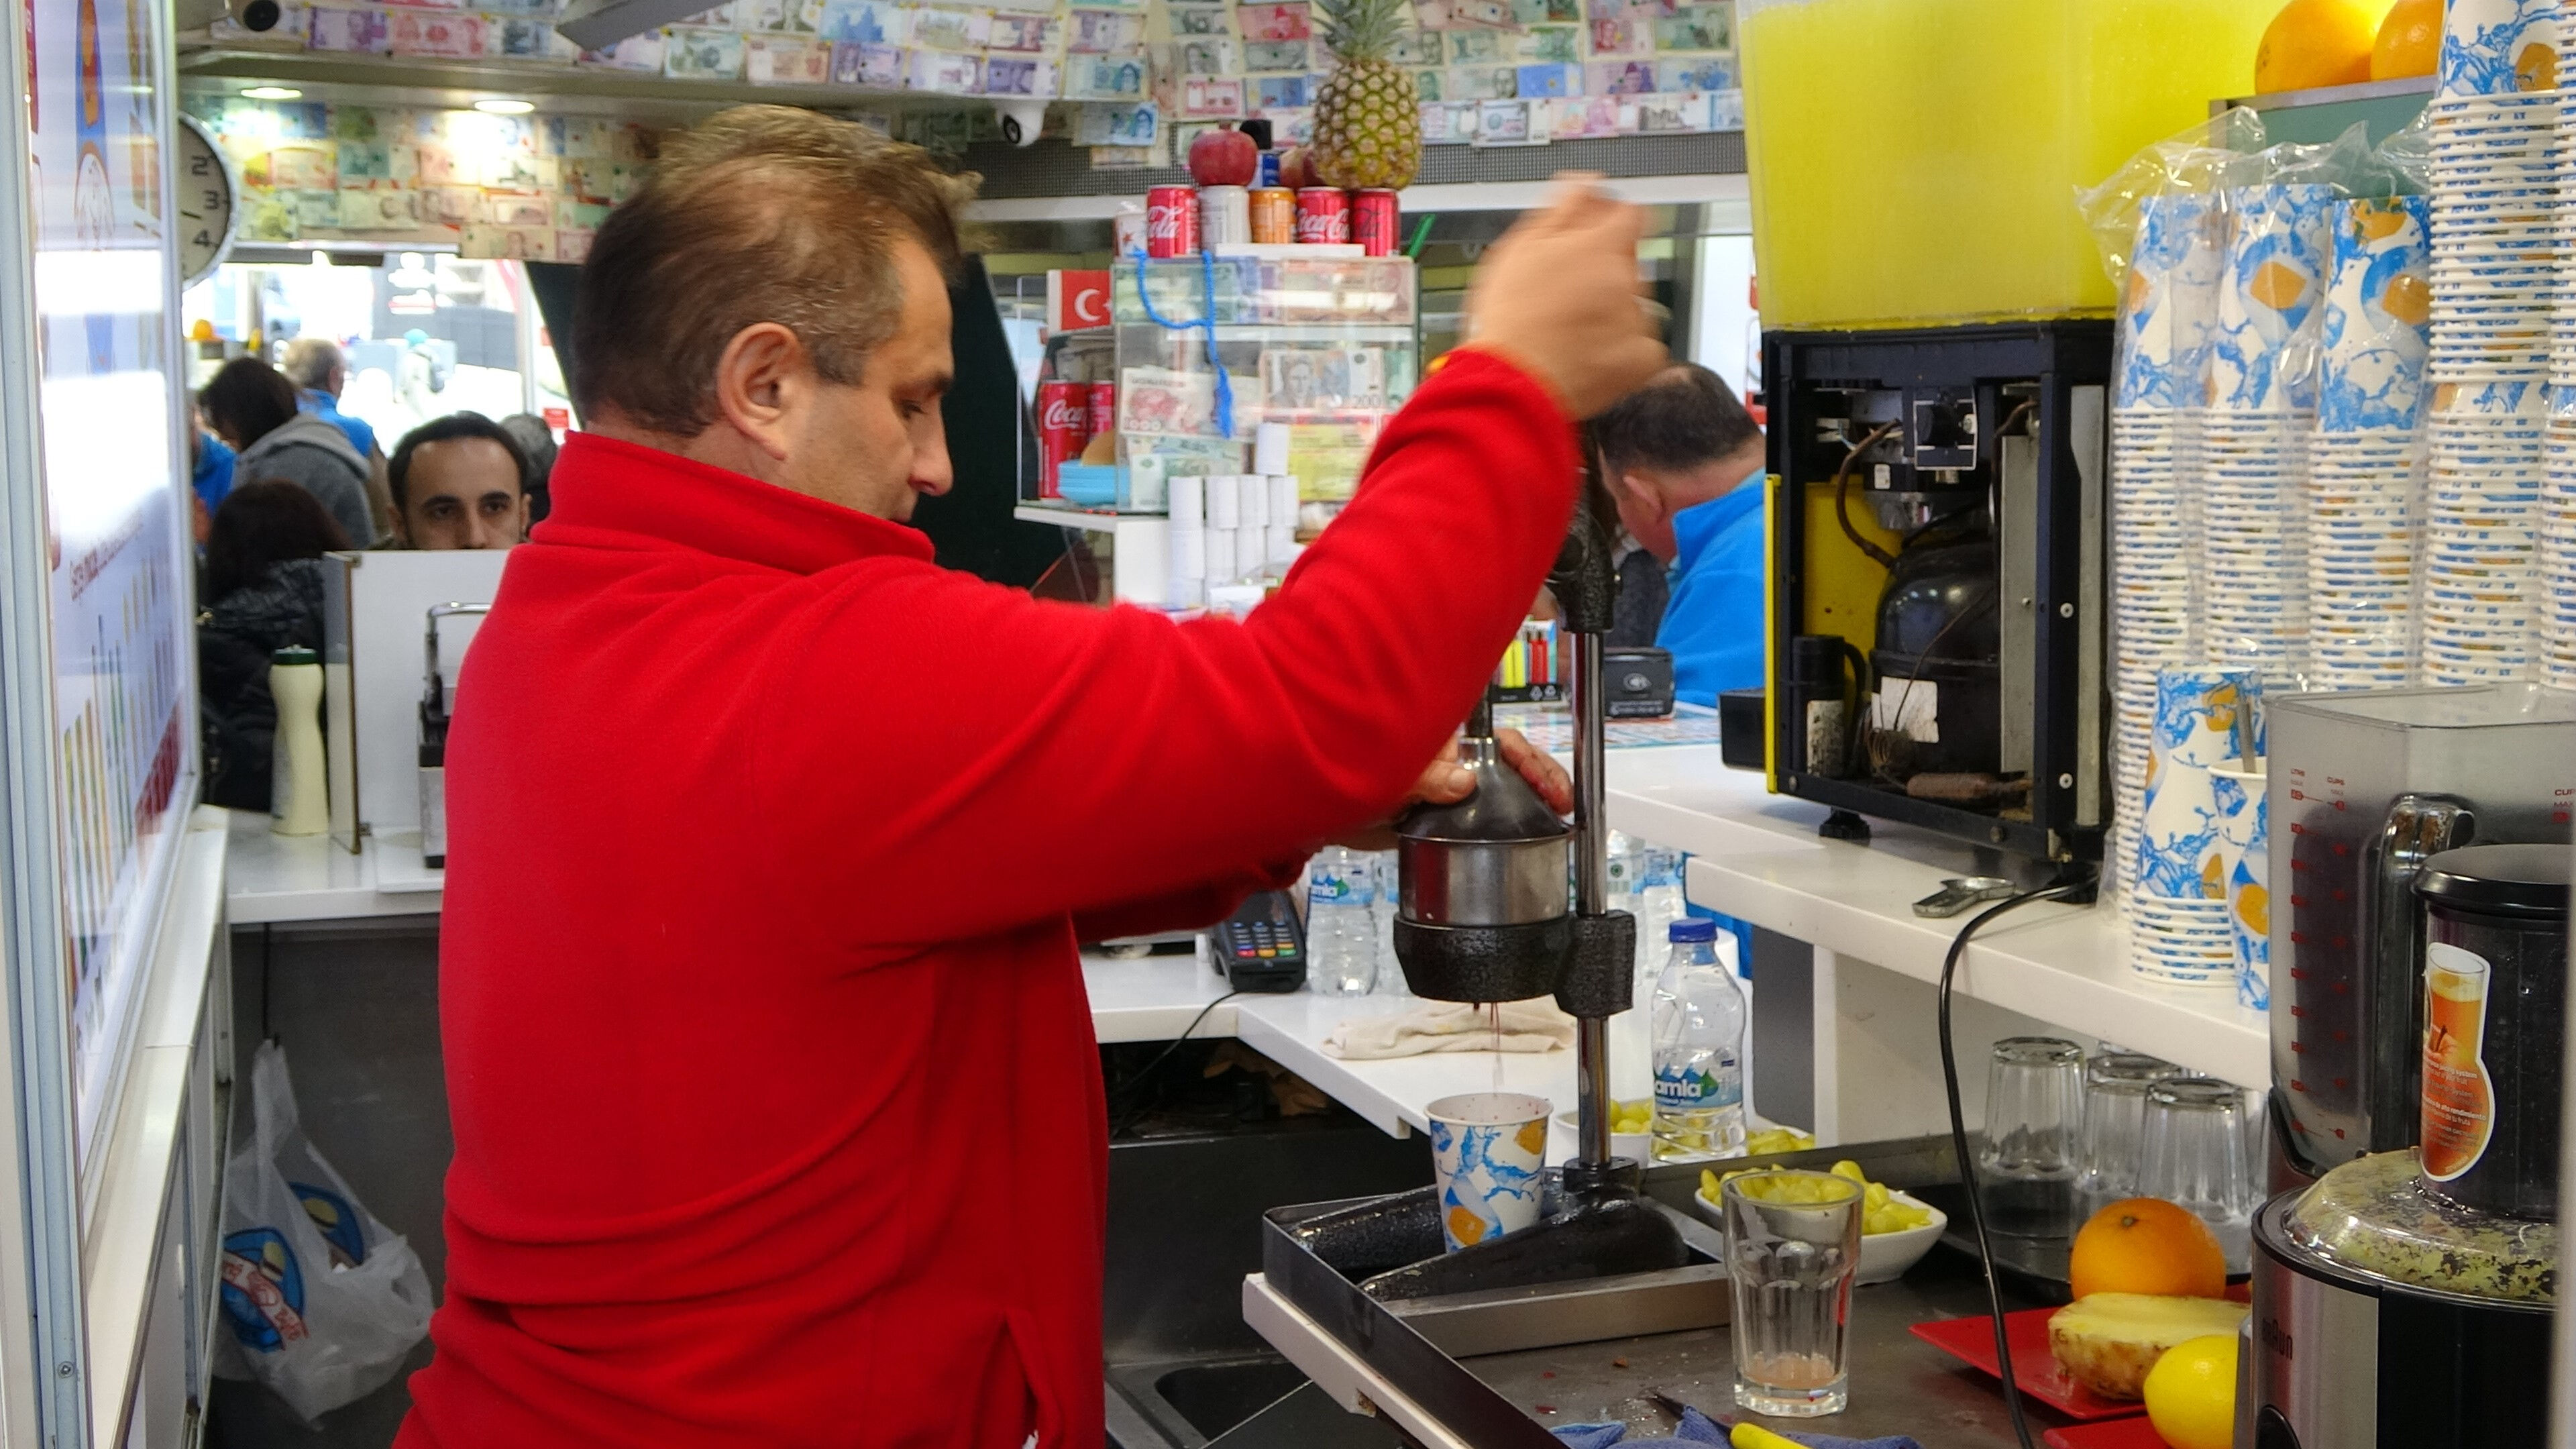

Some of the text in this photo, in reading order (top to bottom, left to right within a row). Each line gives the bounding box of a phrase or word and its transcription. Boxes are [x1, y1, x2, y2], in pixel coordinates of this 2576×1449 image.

[204, 190, 219, 210] 3
[193, 229, 210, 247] 4
[1654, 1078, 1703, 1098] amla
